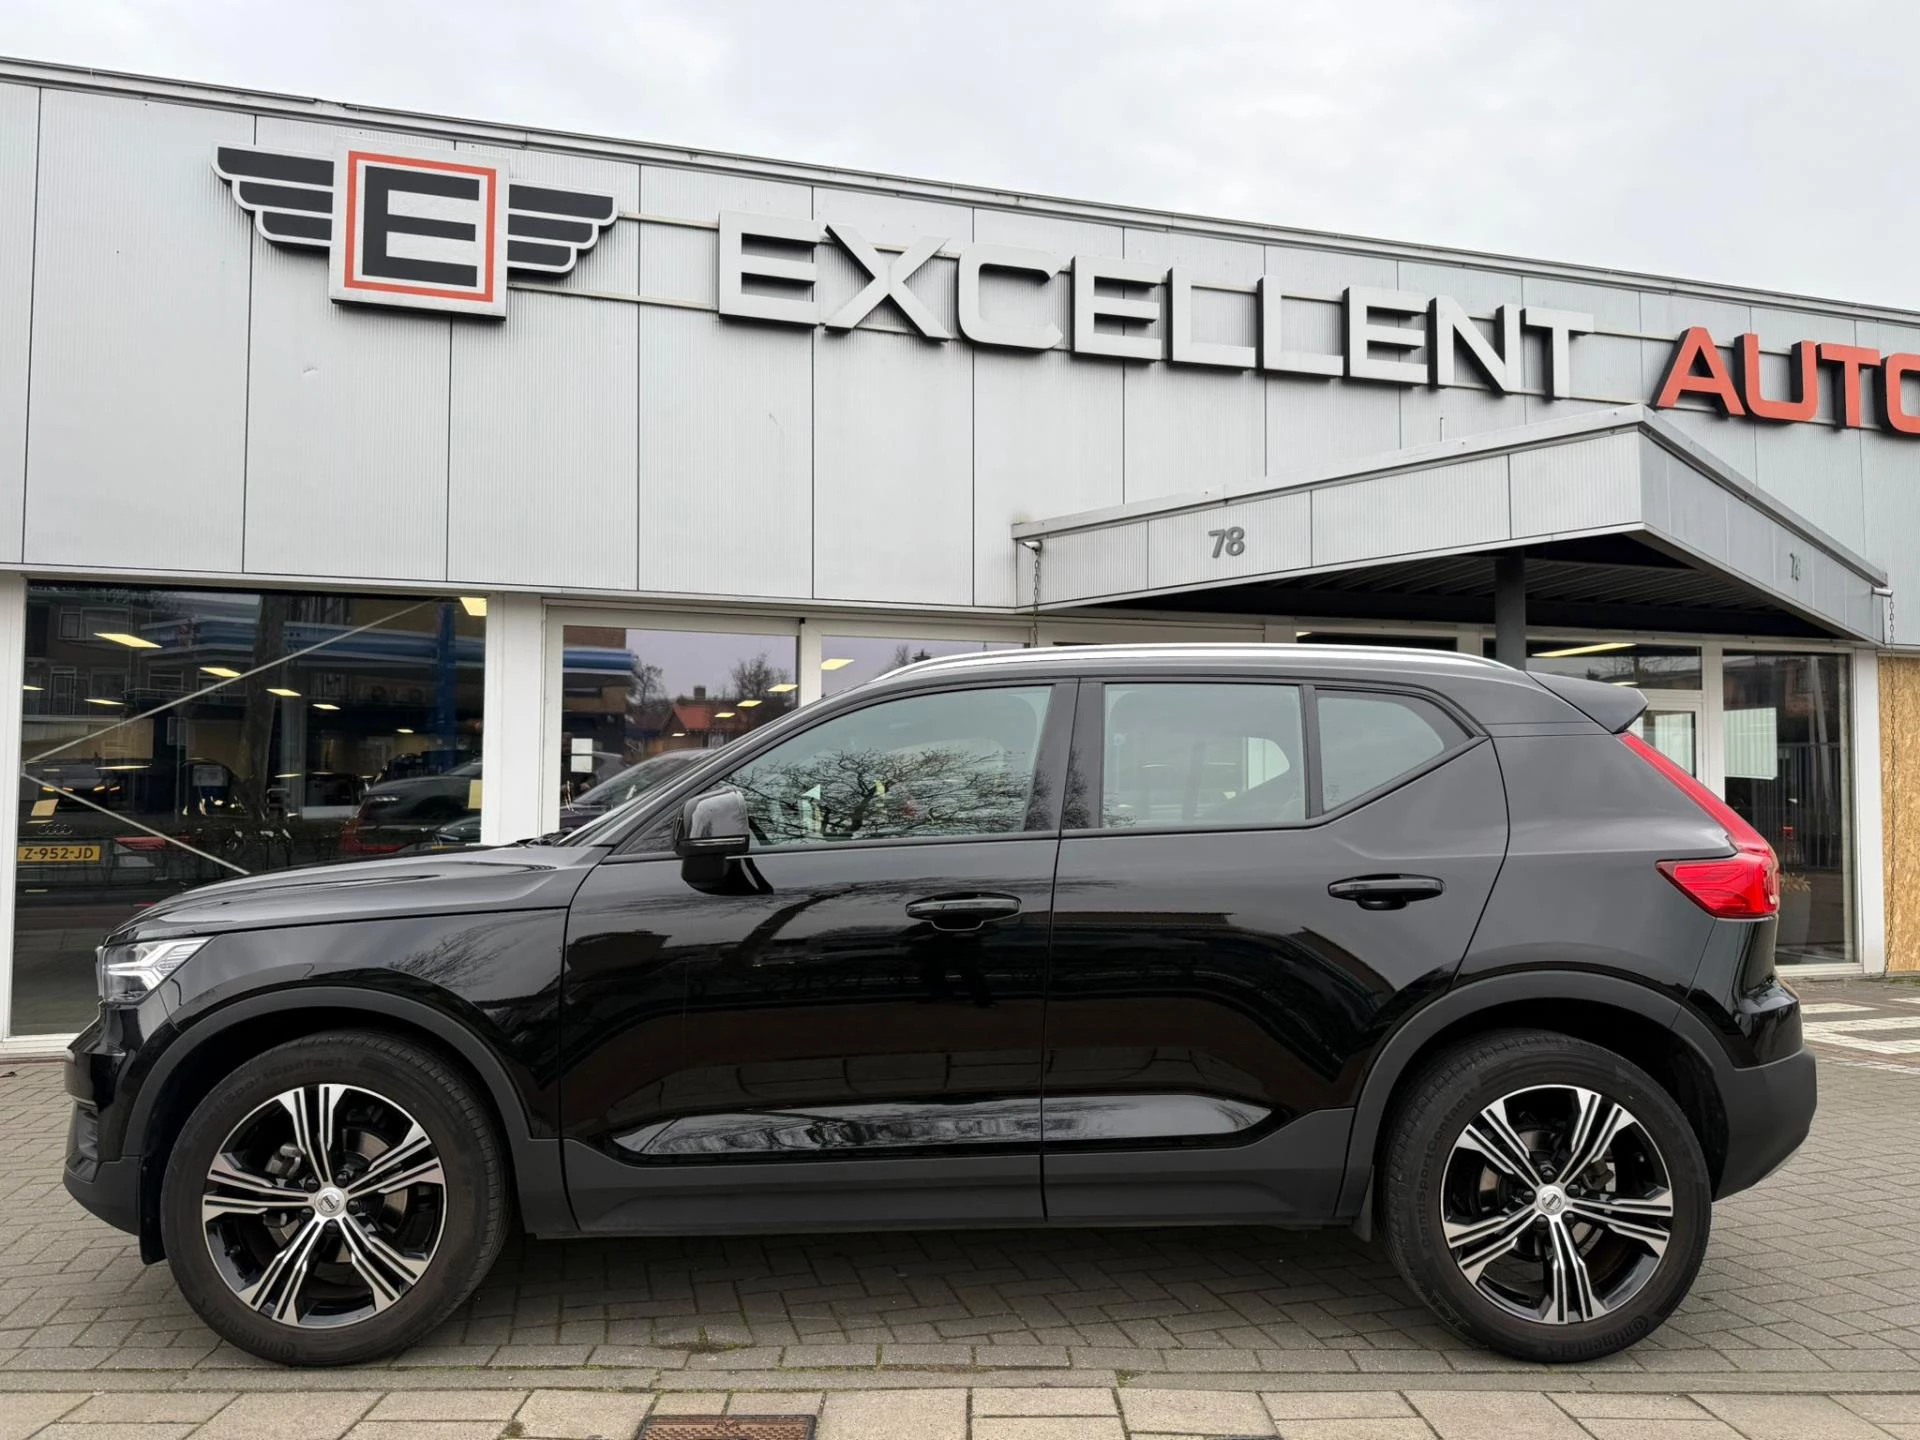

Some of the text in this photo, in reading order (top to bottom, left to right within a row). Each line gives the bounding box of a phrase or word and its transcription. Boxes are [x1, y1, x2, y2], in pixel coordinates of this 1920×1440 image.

[362, 165, 480, 287] E
[718, 209, 1594, 400] EXCELLENT
[1208, 526, 1245, 558] 78
[24, 847, 94, 860] Z-952-JD
